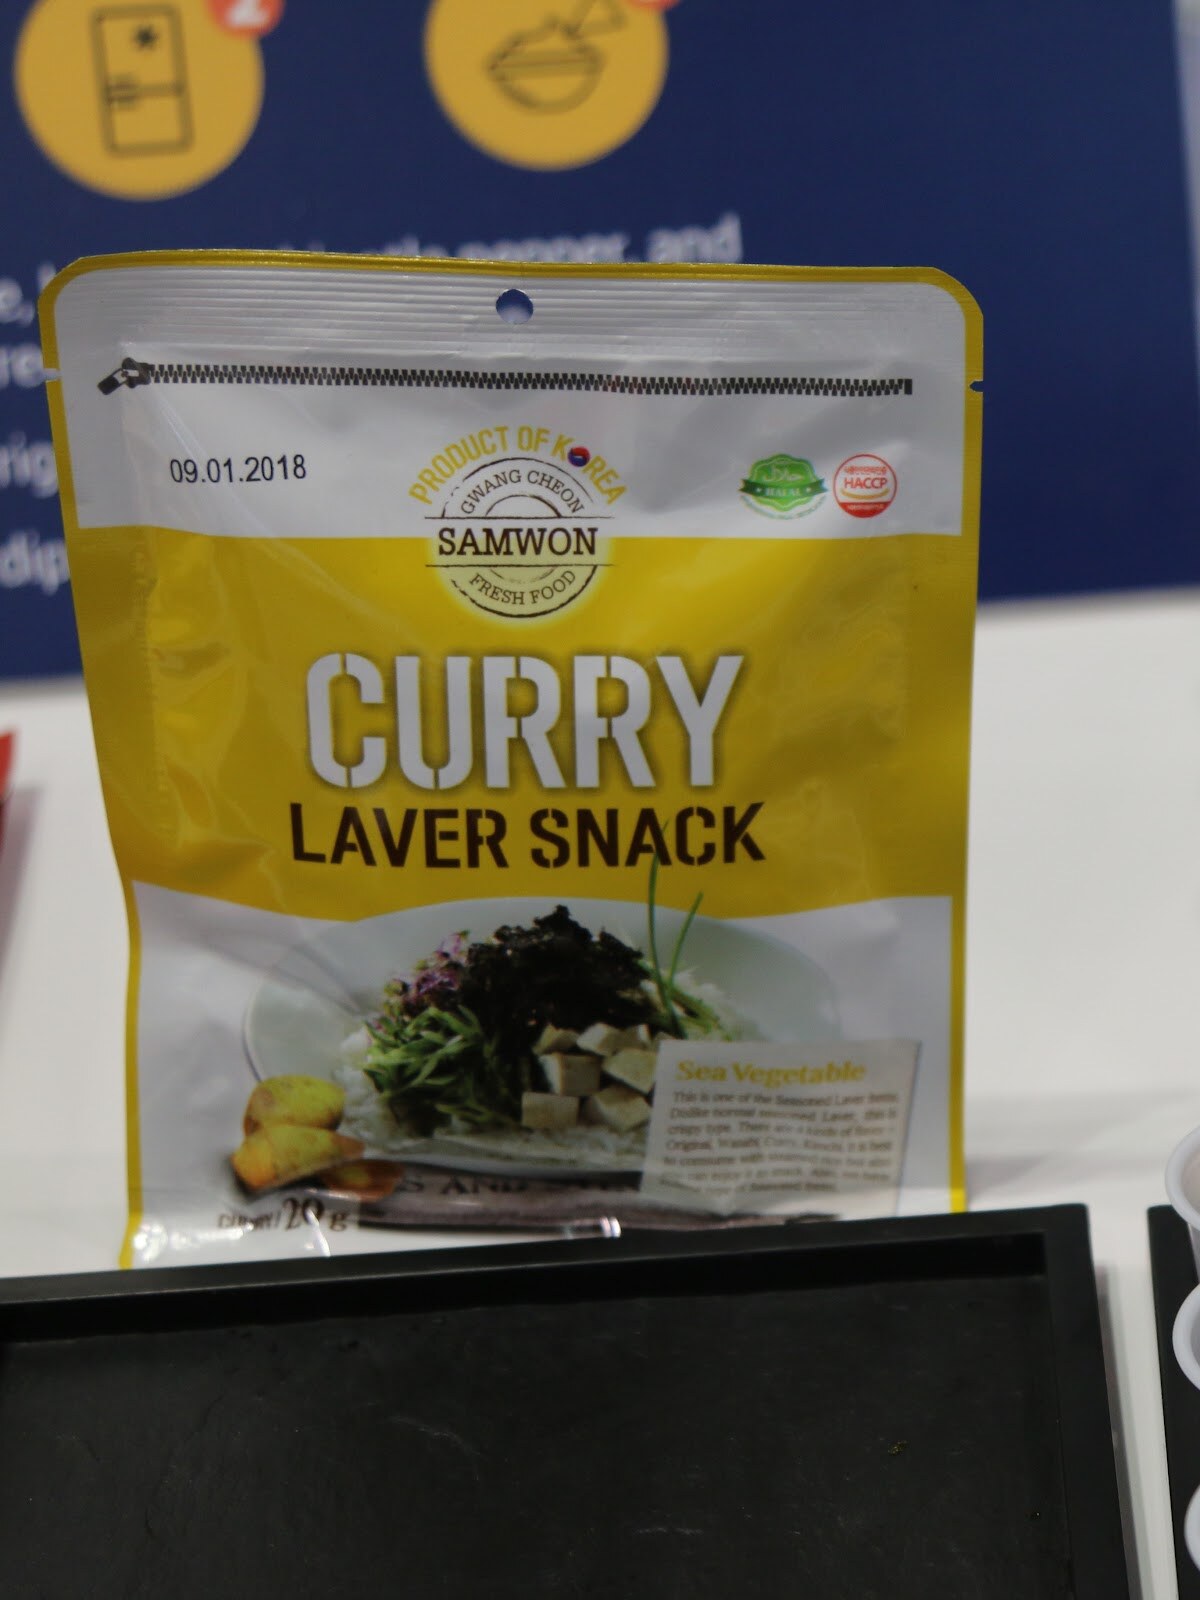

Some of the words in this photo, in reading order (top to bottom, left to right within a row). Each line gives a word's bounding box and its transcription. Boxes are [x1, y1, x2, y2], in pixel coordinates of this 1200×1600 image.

[170, 454, 307, 483] 09.01.2018
[407, 425, 508, 505] PRODUCT
[517, 425, 550, 453] OF
[460, 469, 522, 515] GWANG
[527, 470, 586, 515] CHEON
[844, 477, 888, 490] HACCP
[437, 527, 599, 556] SAMWON
[468, 573, 525, 605] FRESH
[531, 570, 577, 604] FOOD
[306, 652, 745, 790] CURRY
[290, 802, 510, 869] LAVER
[529, 801, 767, 869] SNACK
[676, 1060, 728, 1083] Sea
[731, 1060, 867, 1088] Vegetable
